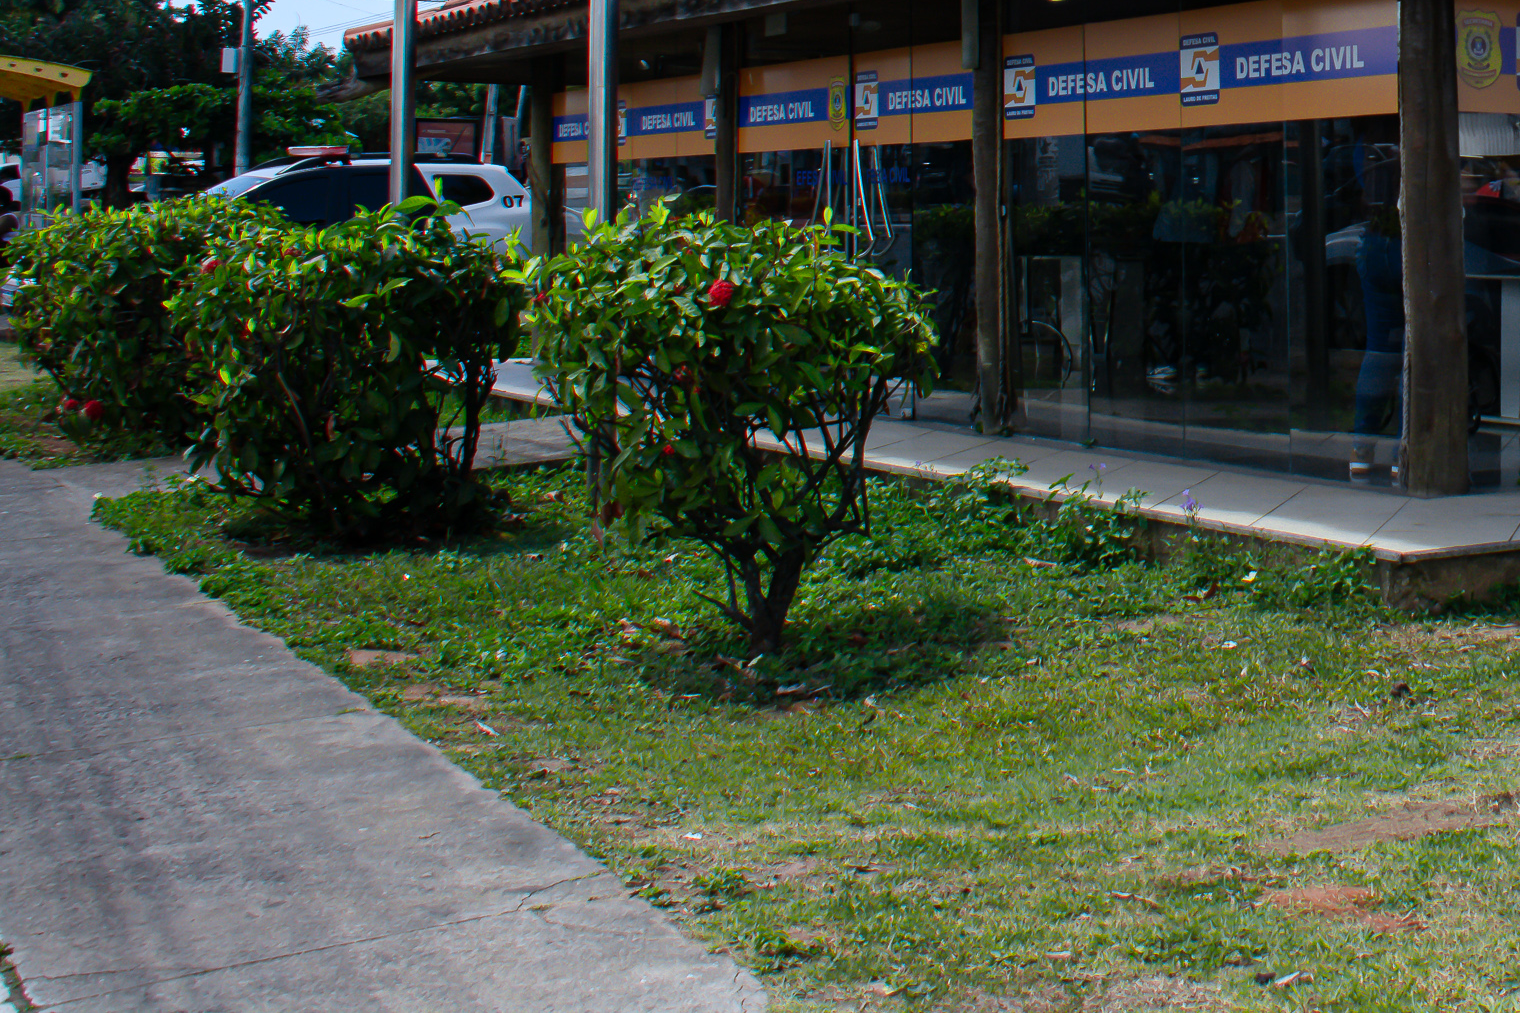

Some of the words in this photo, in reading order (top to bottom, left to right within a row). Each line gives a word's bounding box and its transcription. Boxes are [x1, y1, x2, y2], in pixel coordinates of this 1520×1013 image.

[1182, 36, 1202, 47] DEFESA
[1202, 35, 1216, 45] CIVIL
[1236, 50, 1306, 80] DEFESA
[1311, 44, 1365, 73] CIVIL
[1048, 71, 1108, 97] DEFESA
[1111, 67, 1155, 91] CIVIL
[888, 88, 931, 110] DEFESA
[934, 85, 967, 106] CIVIL
[642, 113, 673, 131] DEFESA
[673, 110, 696, 128] CIVIL
[750, 104, 787, 123] DEFESA
[788, 101, 815, 119] CIVIL
[558, 122, 584, 138] DEFESA
[502, 194, 525, 209] 07
